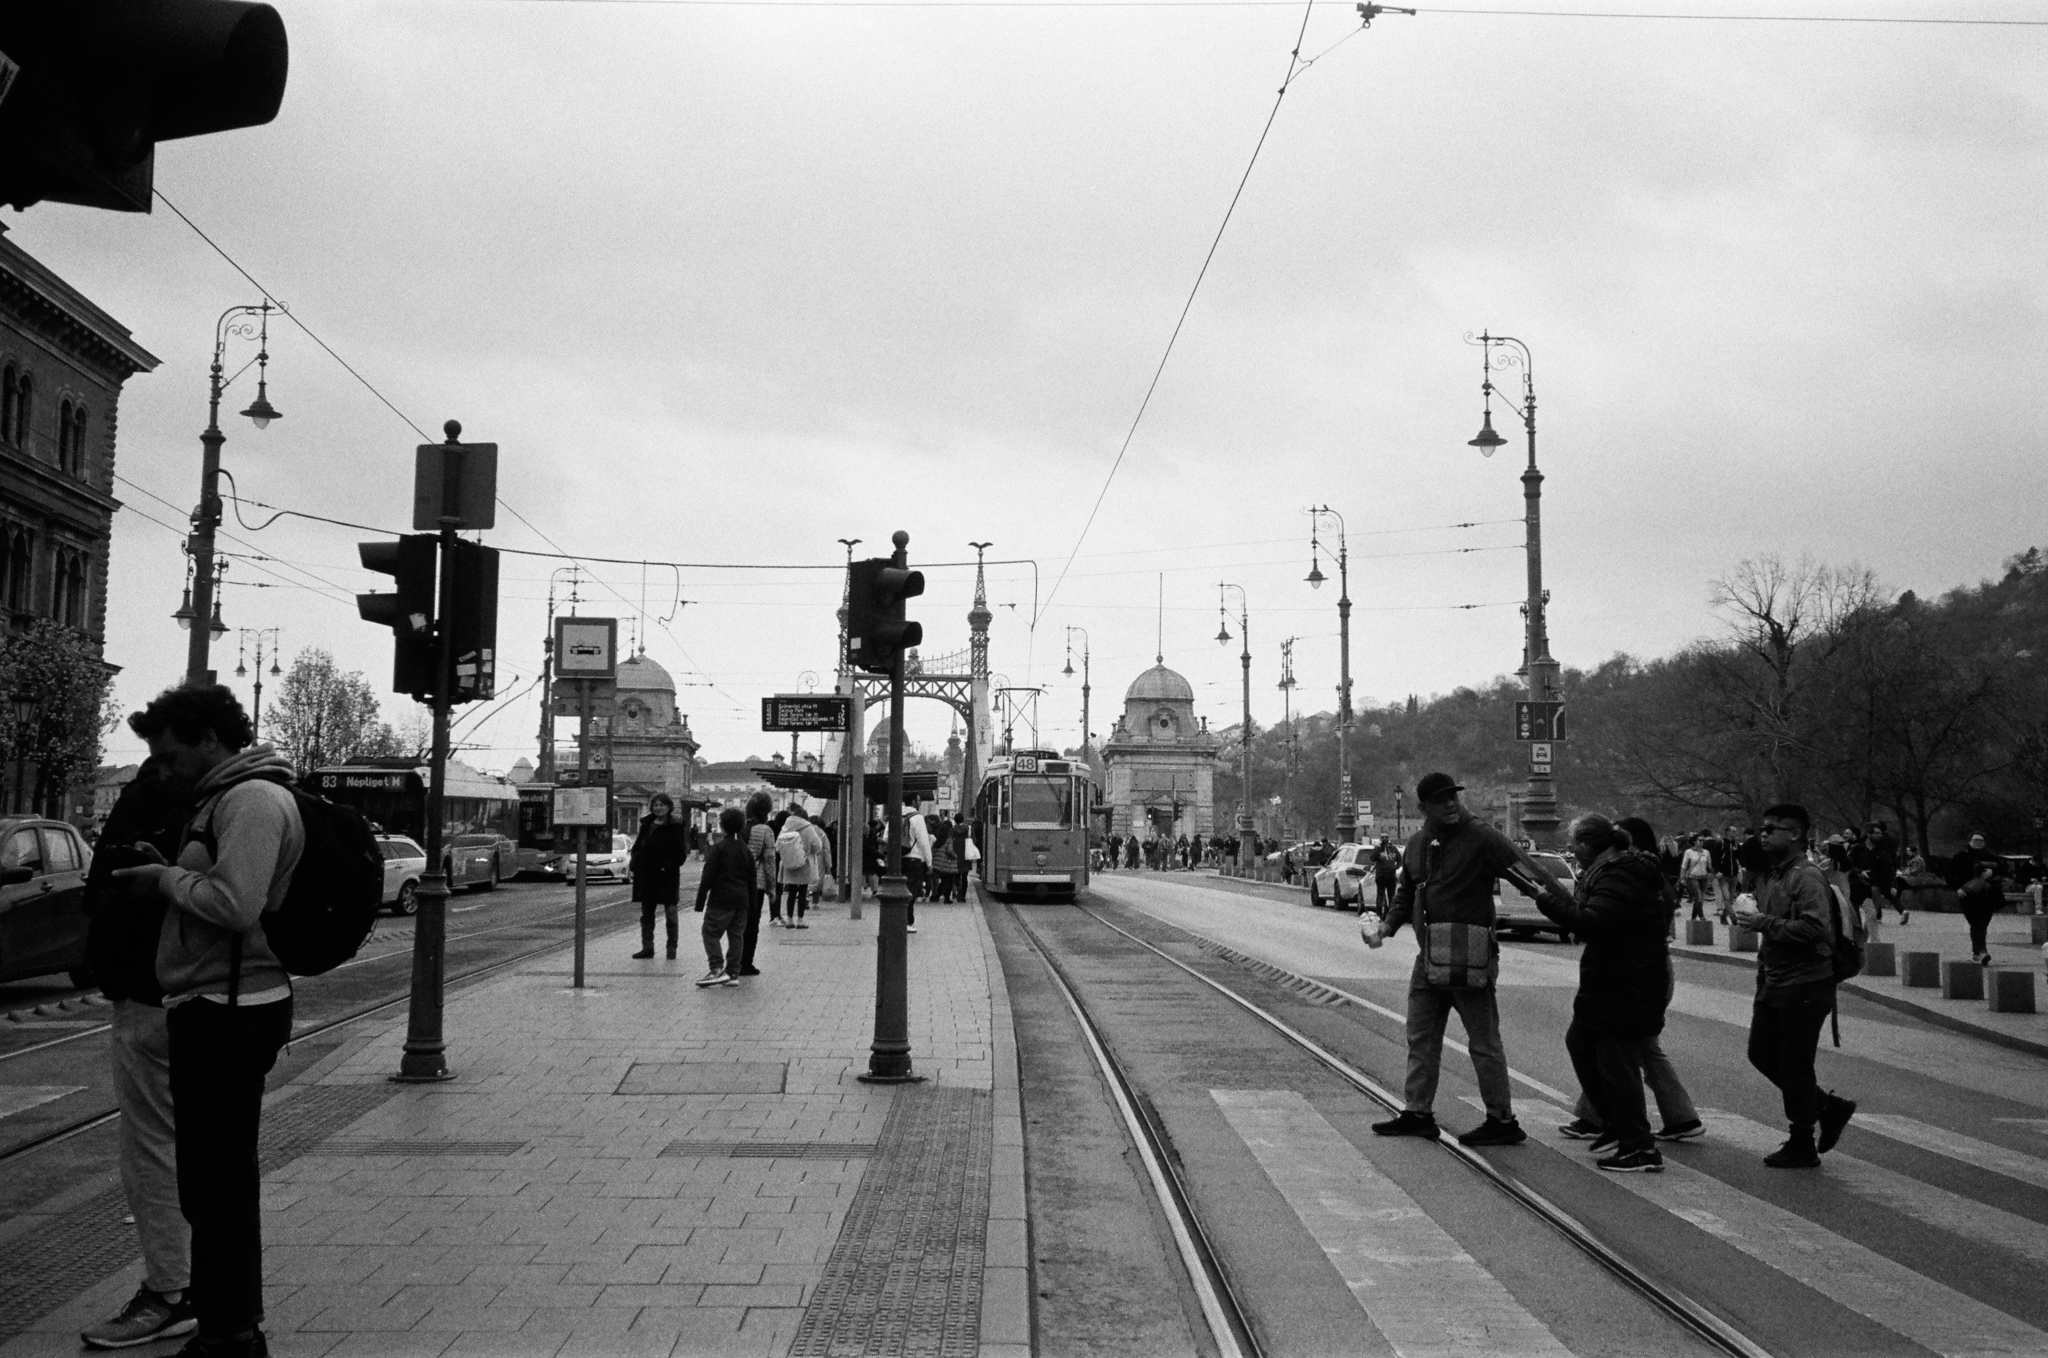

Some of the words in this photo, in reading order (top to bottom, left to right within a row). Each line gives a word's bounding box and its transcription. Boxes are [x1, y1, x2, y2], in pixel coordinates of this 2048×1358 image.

[1017, 758, 1034, 770] 48
[322, 775, 337, 788] 83
[346, 776, 389, 788] Népliget
[392, 776, 400, 787] M
